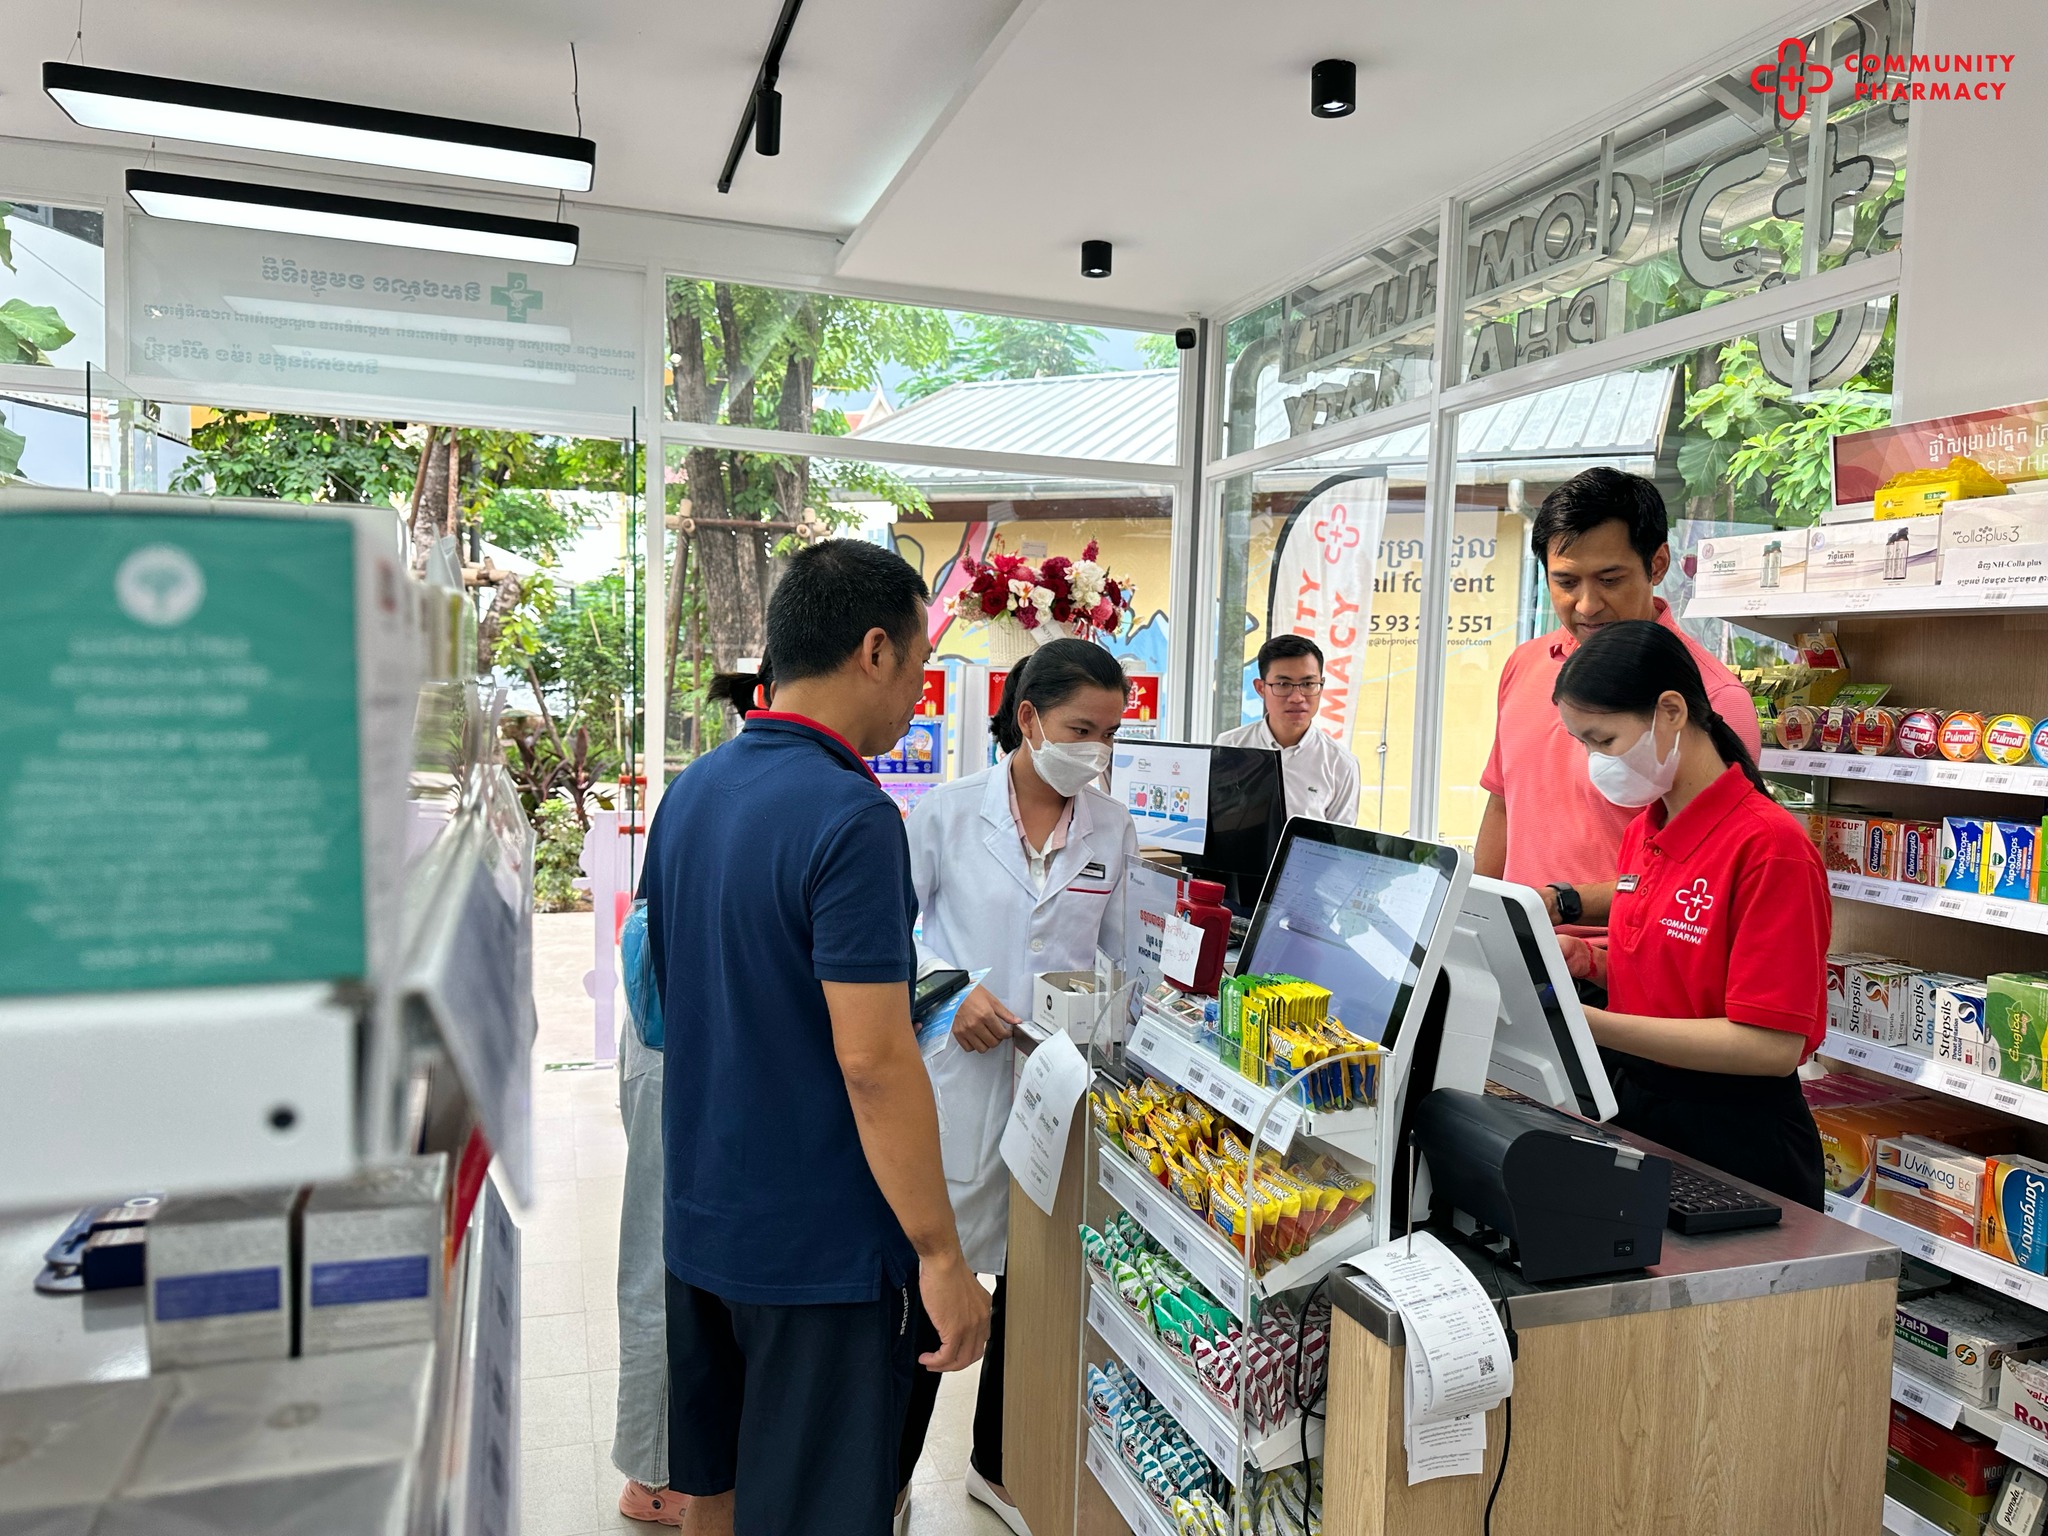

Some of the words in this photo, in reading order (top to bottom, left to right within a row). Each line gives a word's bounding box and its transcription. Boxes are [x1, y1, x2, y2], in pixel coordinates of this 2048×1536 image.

[1450, 574, 1495, 593] ent
[2027, 559, 2042, 568] plus
[1386, 615, 1409, 632] 93
[1458, 615, 1492, 633] 551
[1902, 726, 1931, 742] Pulmoll
[1943, 731, 1974, 743] Pulmoll
[1991, 730, 2022, 747] Pulmoll
[1829, 820, 1860, 831] ZECUF
[1870, 828, 1881, 872] Chloraseptic
[1907, 833, 1917, 878] Chloraseptic
[1956, 831, 1968, 879] VapoDrops
[2006, 836, 2018, 886] VapoDrops
[1849, 975, 1863, 1034] Strepsils
[1913, 984, 1926, 1043] Strepsils
[1939, 1000, 1953, 1059] Strepsils
[2008, 1013, 2024, 1062] Eugica
[2020, 1174, 2046, 1255] Sargenor
